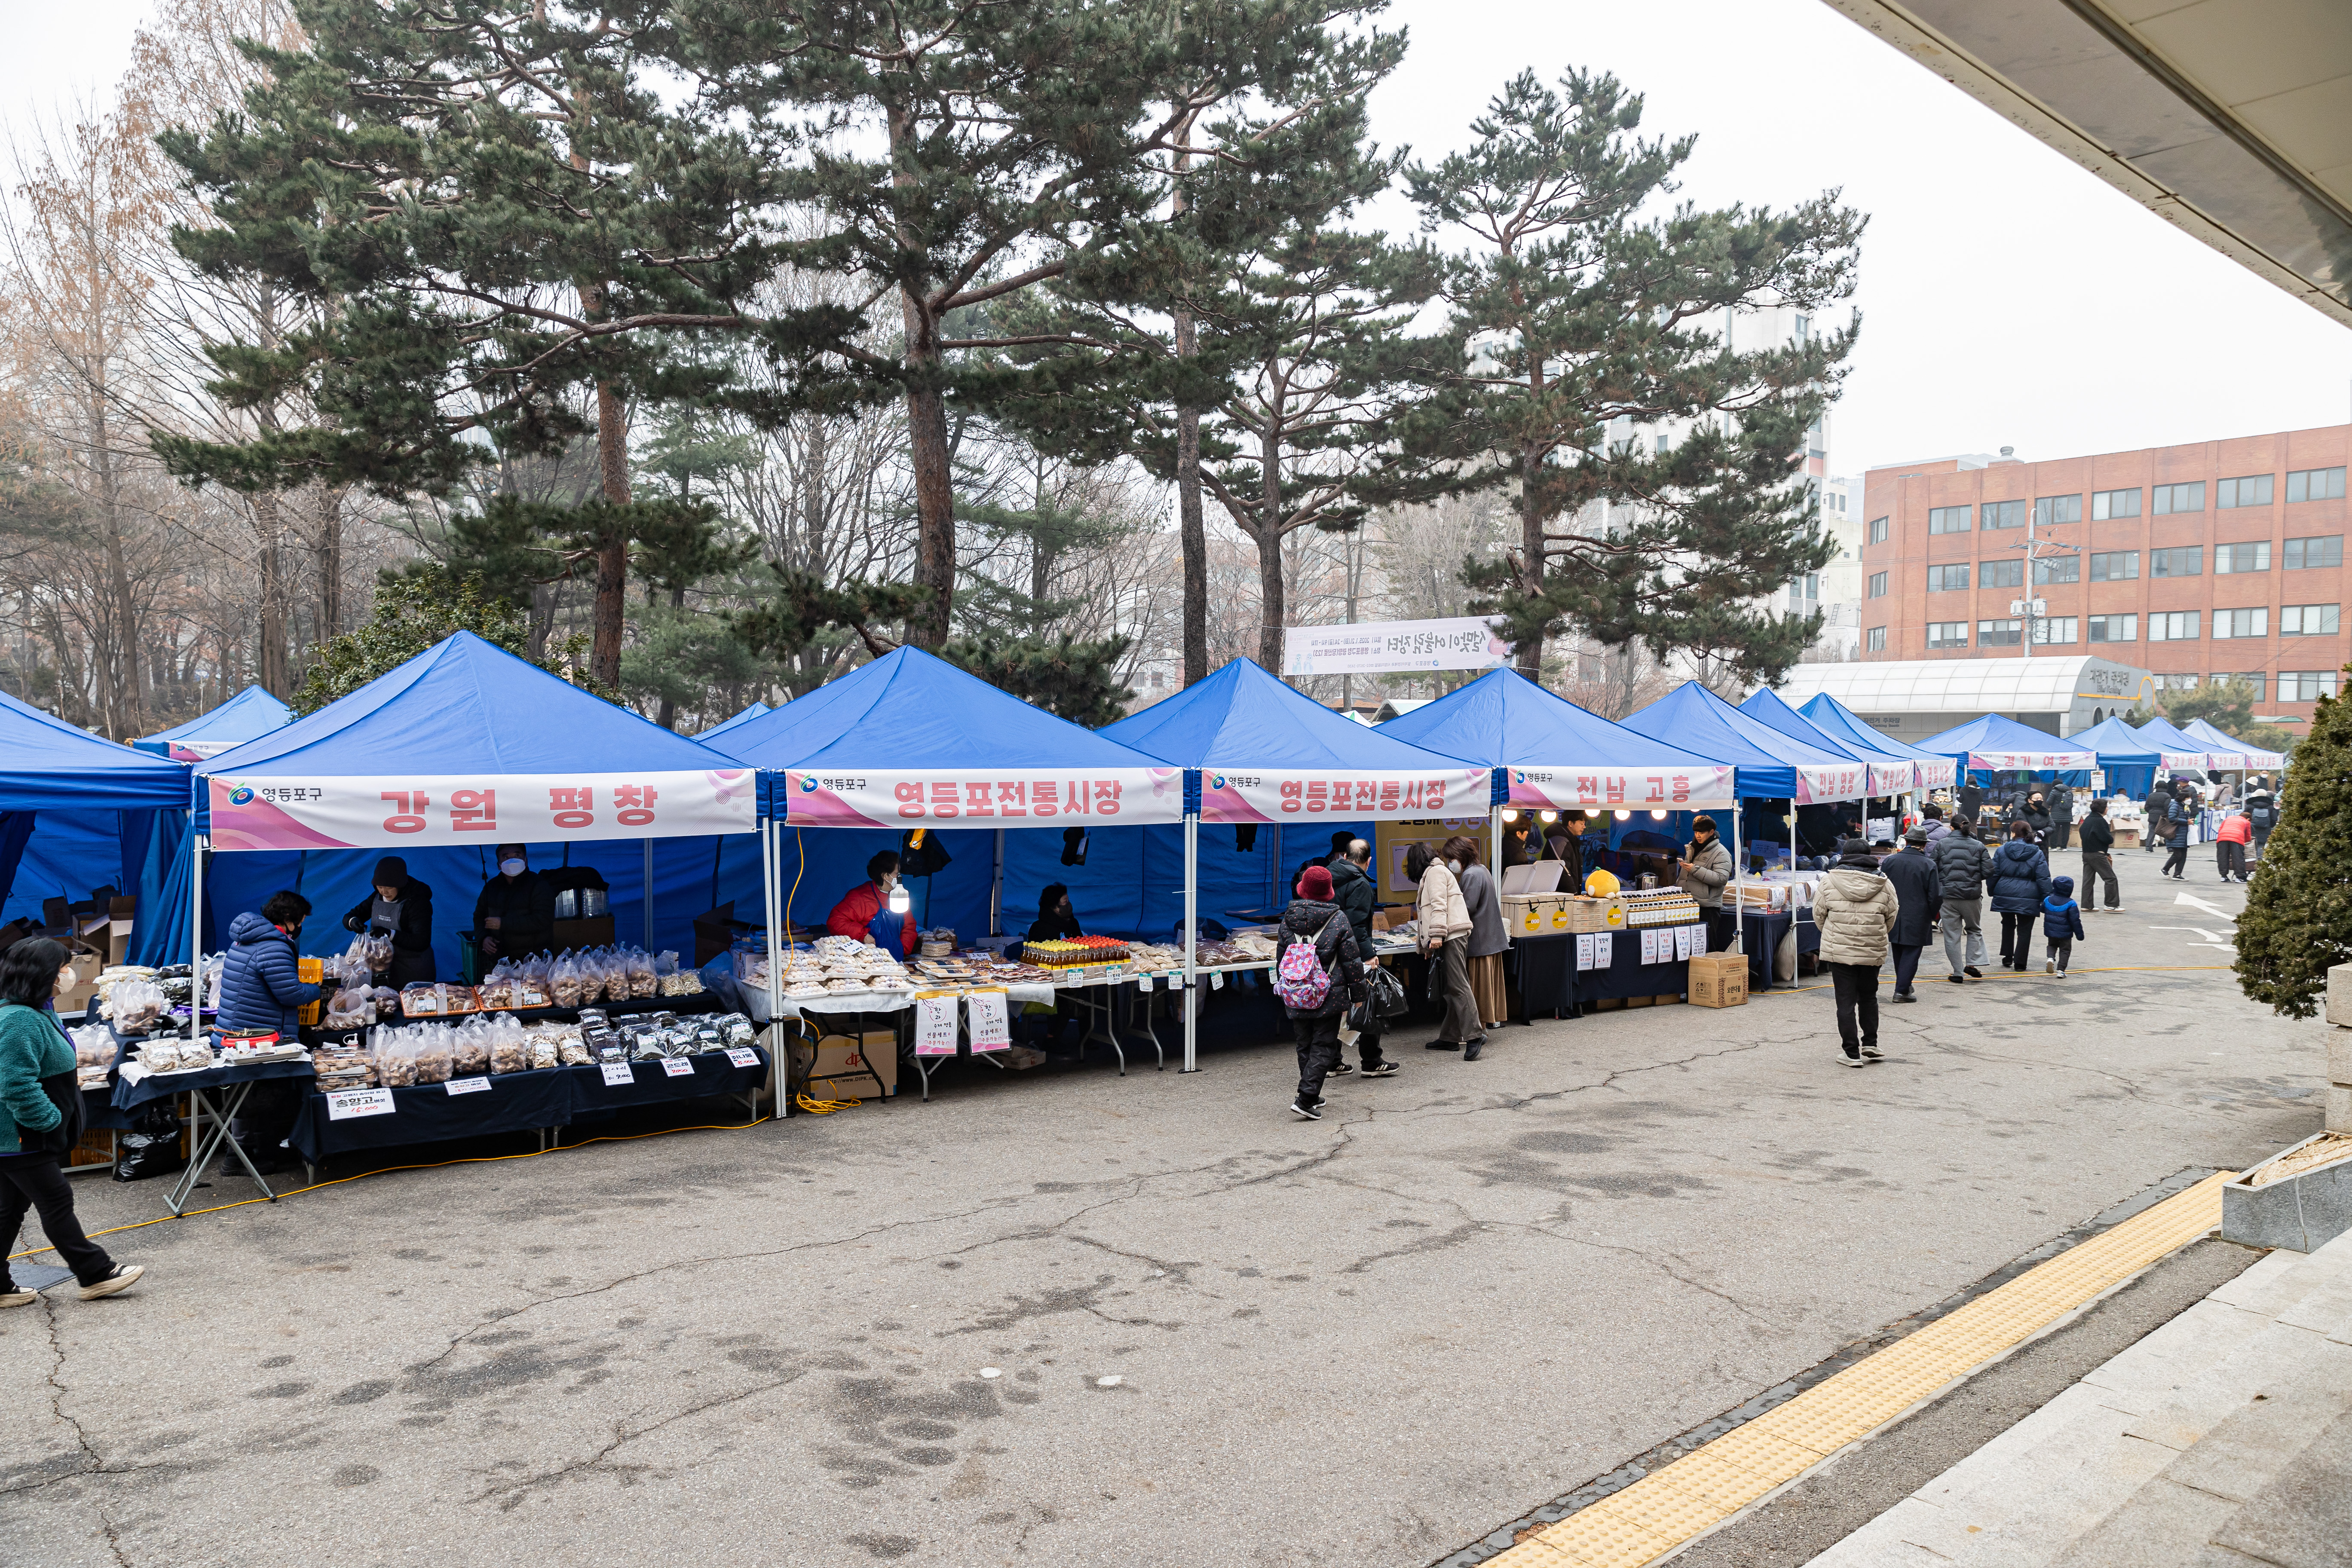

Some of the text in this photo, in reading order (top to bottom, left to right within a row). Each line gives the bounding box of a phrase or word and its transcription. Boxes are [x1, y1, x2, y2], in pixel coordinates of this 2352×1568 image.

[2004, 756, 2069, 766] 경기 여주
[823, 778, 867, 791] 영등포구
[1228, 777, 1261, 787] 영등포구
[1527, 773, 1553, 783] 영등포구
[1819, 771, 1854, 796] 전남 영광
[262, 787, 322, 802] 영등포구
[1280, 779, 1446, 813] 영등포전통시장
[1576, 775, 1690, 804] 전남 고흥
[894, 780, 1122, 818] 영등포전통시장
[381, 784, 658, 834] 강원 평창
[935, 1007, 941, 1020] 한과
[985, 1004, 992, 1017] 한과
[827, 1075, 882, 1084] http://www.DIPK.cor
[336, 1096, 374, 1108] 송향고
